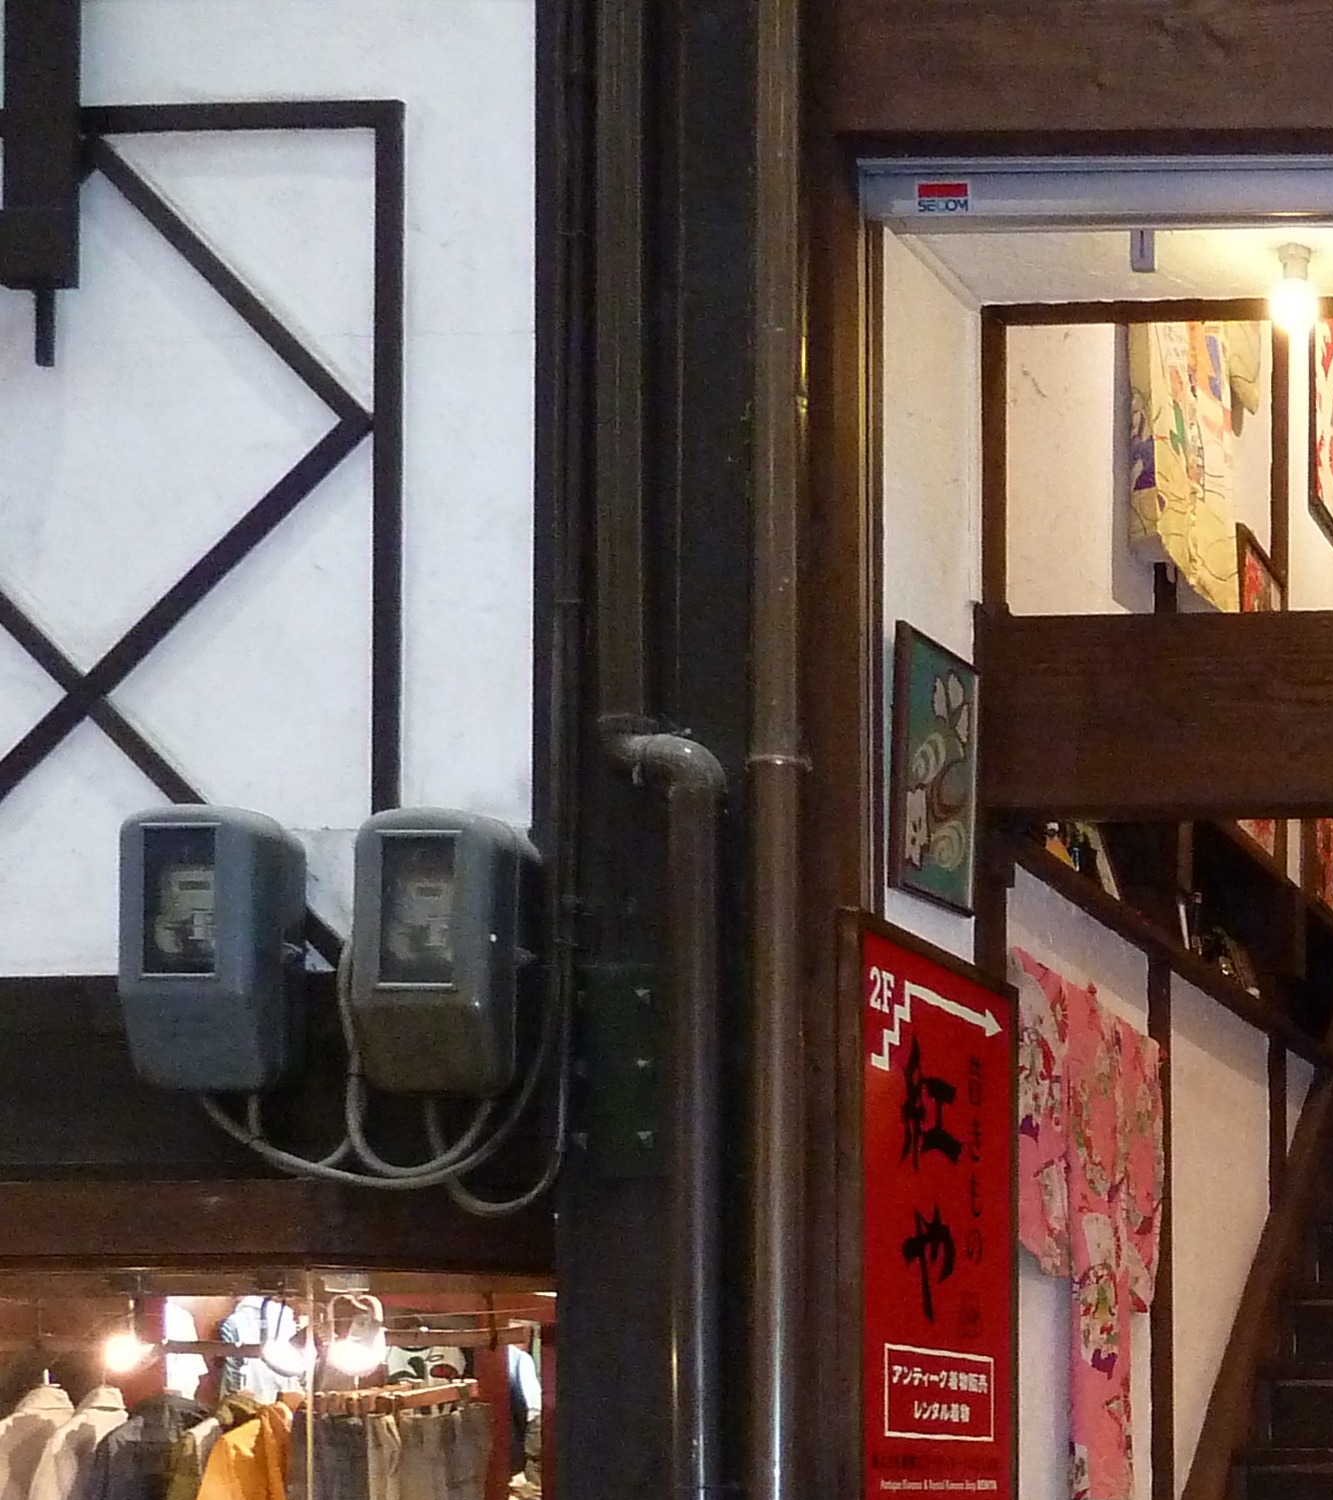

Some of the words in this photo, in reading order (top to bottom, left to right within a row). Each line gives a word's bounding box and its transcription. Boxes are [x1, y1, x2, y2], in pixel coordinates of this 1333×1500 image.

[918, 200, 968, 212] SECOM
[869, 966, 894, 1013] 2F
[900, 1034, 962, 1325] 紅や
[914, 1400, 970, 1422] レンタル着物
